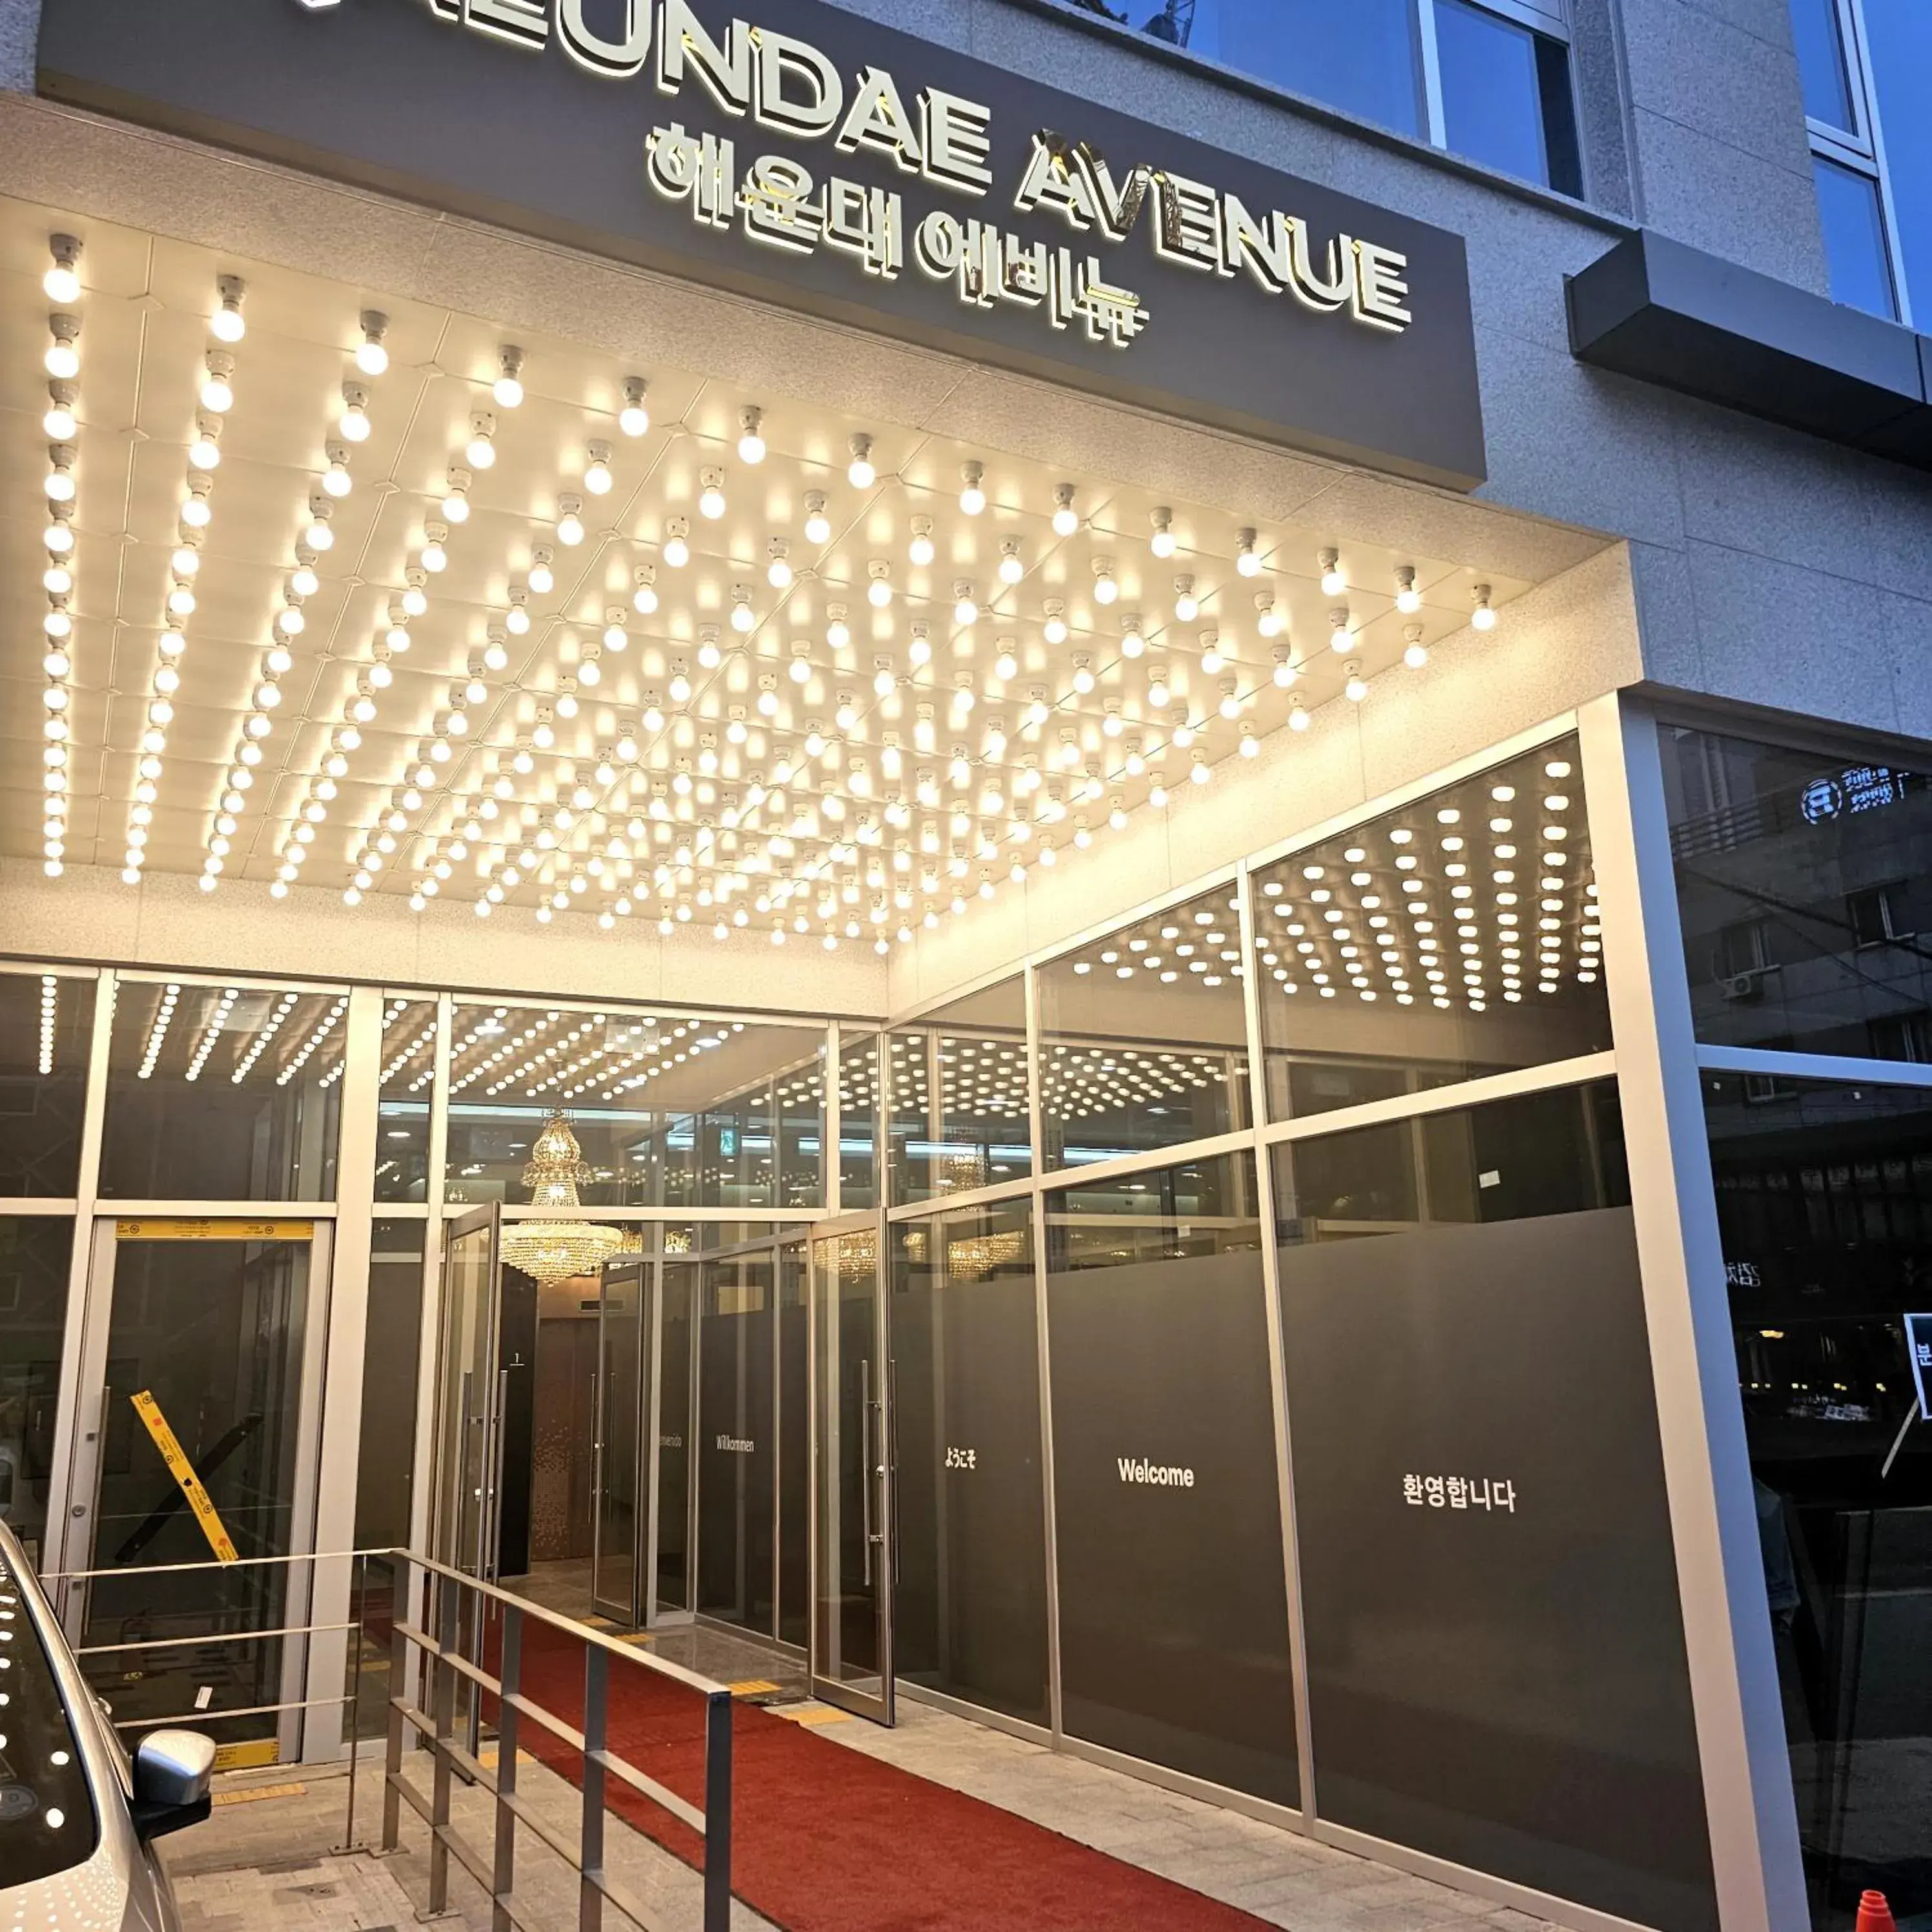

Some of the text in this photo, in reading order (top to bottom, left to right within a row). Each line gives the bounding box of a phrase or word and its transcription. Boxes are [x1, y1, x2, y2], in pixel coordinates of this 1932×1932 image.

[647, 123, 1149, 346] 해운대 에비뉴
[1015, 128, 1412, 333] AVENUE
[716, 1434, 754, 1452] Willkommen
[945, 1447, 976, 1469] ようこそ
[1118, 1457, 1194, 1487] Welcome
[1403, 1474, 1516, 1513] 환영합니다
